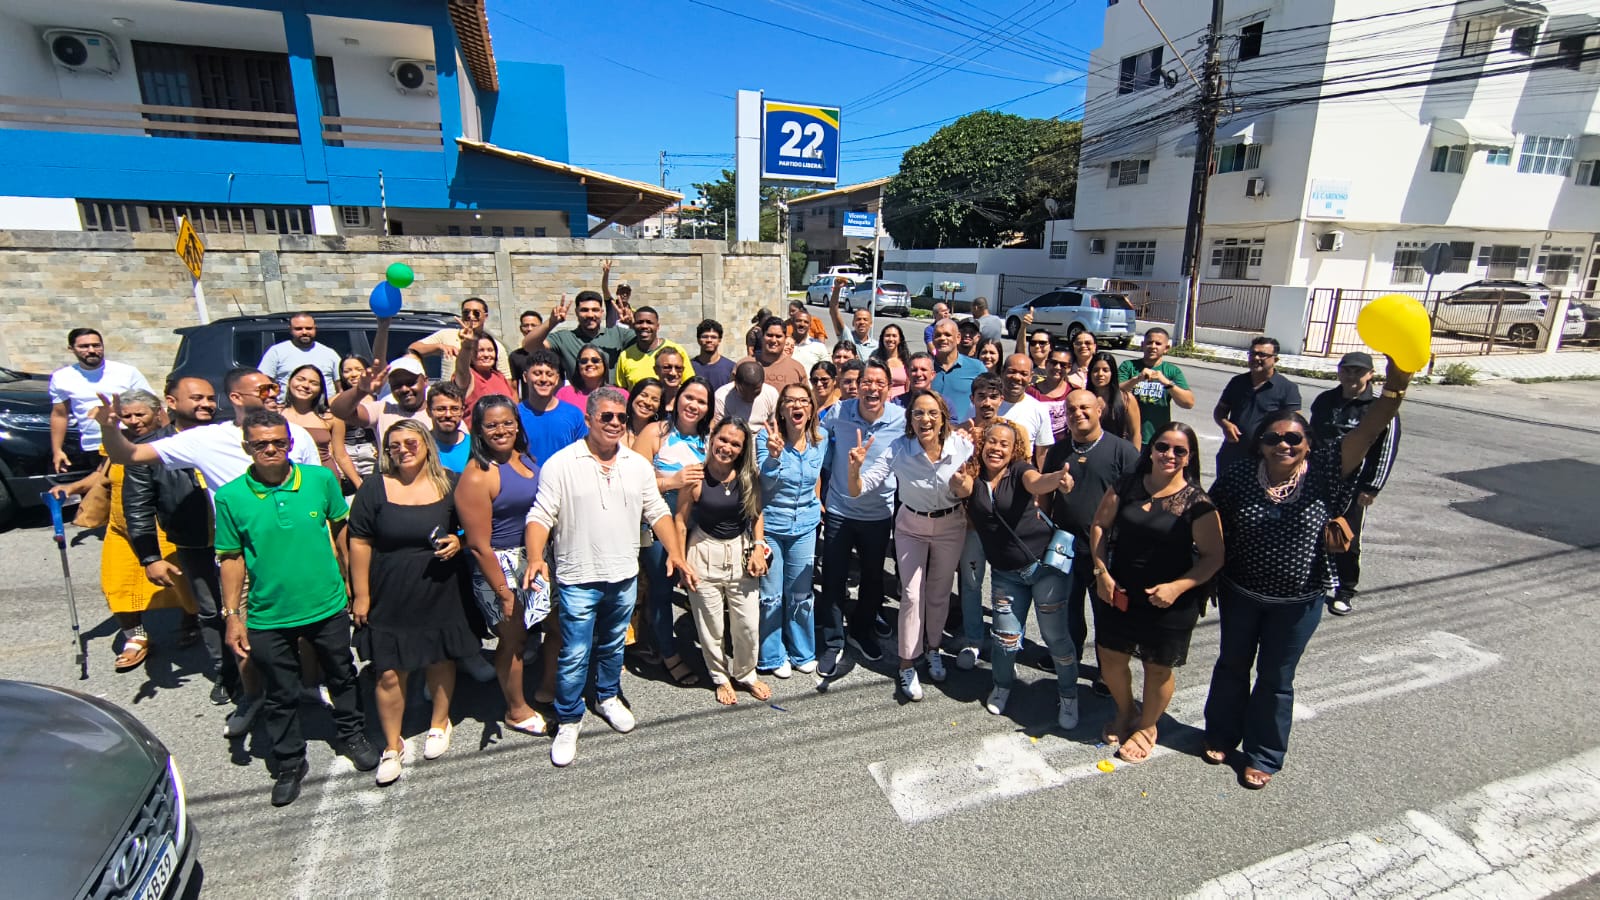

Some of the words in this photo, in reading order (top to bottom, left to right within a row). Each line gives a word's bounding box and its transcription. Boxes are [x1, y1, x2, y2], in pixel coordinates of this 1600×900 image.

[779, 120, 825, 159] 22
[778, 160, 802, 168] PARTIDO
[143, 853, 171, 900] 6B39
